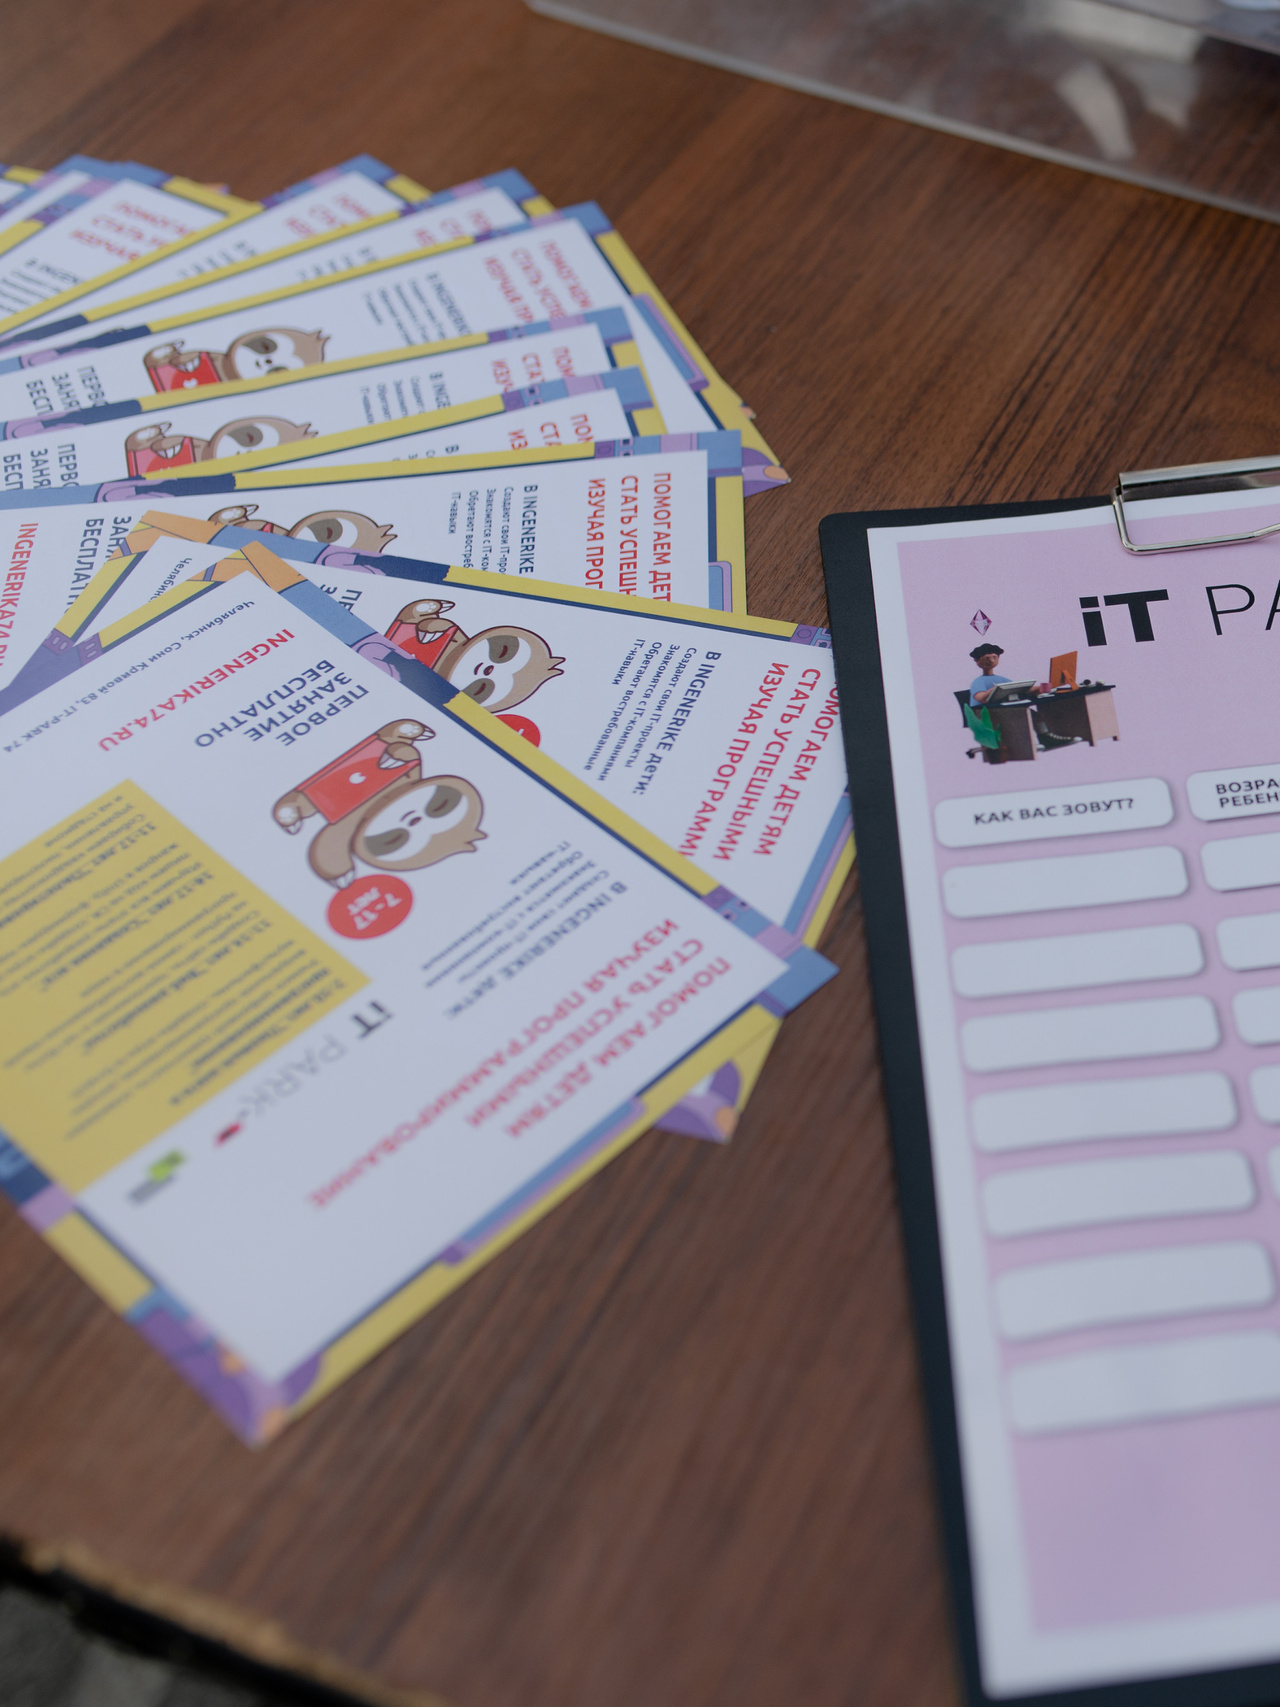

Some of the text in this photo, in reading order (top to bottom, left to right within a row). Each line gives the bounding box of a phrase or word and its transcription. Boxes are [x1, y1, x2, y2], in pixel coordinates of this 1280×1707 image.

[26, 380, 54, 416] БЕСП
[52, 373, 82, 414] ЗАНЯ
[3, 453, 24, 491] БЕСП
[30, 448, 52, 489] ЗАНЯ
[620, 475, 639, 525] СТАТЬ
[462, 534, 474, 568] востреб
[519, 497, 537, 574] INGENERIKE
[584, 479, 605, 589] ИЗУЧАЯ ПРОГ
[648, 473, 671, 602] ПОМОГАЕМ ДЕТ
[3, 601, 255, 753] Челябинск, Сони Кривой 83, IT-PARK 74
[99, 629, 295, 751] INGENERIKA74.RU
[612, 639, 646, 685] IT-навыки
[642, 644, 680, 699] Знакомятся
[737, 662, 789, 734] ИЗУЧАЯ
[195, 660, 335, 747] БЕСПЛАТНО
[243, 672, 352, 742] ЗАНЯТИЕ
[276, 684, 369, 746] ПЕРВОЕ
[584, 642, 662, 771] Обретают востребованные
[625, 647, 697, 768] Создают свои IT-проекты
[633, 651, 722, 795] В INGENERIKE дети:
[598, 707, 646, 781] IT-компаниями
[713, 668, 821, 860] СТАТЬ УСПЕШНЫМИ
[753, 681, 844, 855] ОМОГАЕМ ДЕТЯМ
[974, 797, 1135, 825] КАК ВАС ЗОВУТ?
[583, 919, 679, 993] ИЗУЧАЯ
[628, 938, 704, 995] СТАТЬ
[593, 957, 731, 1067] ПОМОГАЕМ
